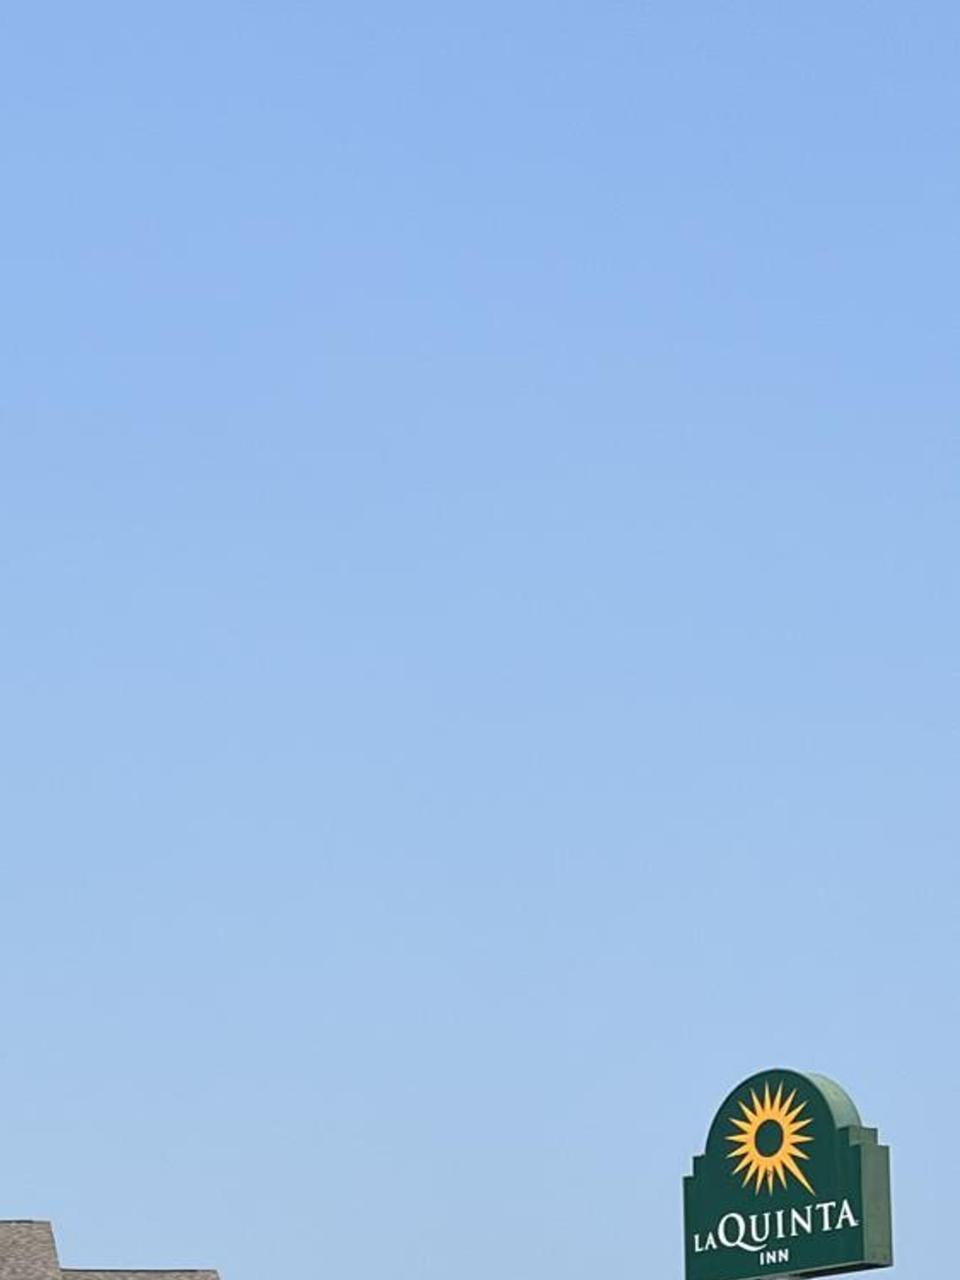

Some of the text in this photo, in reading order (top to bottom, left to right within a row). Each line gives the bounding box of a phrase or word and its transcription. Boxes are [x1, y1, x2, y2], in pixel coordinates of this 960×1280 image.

[694, 1199, 859, 1252] LA QUINTA
[759, 1248, 789, 1265] INN
